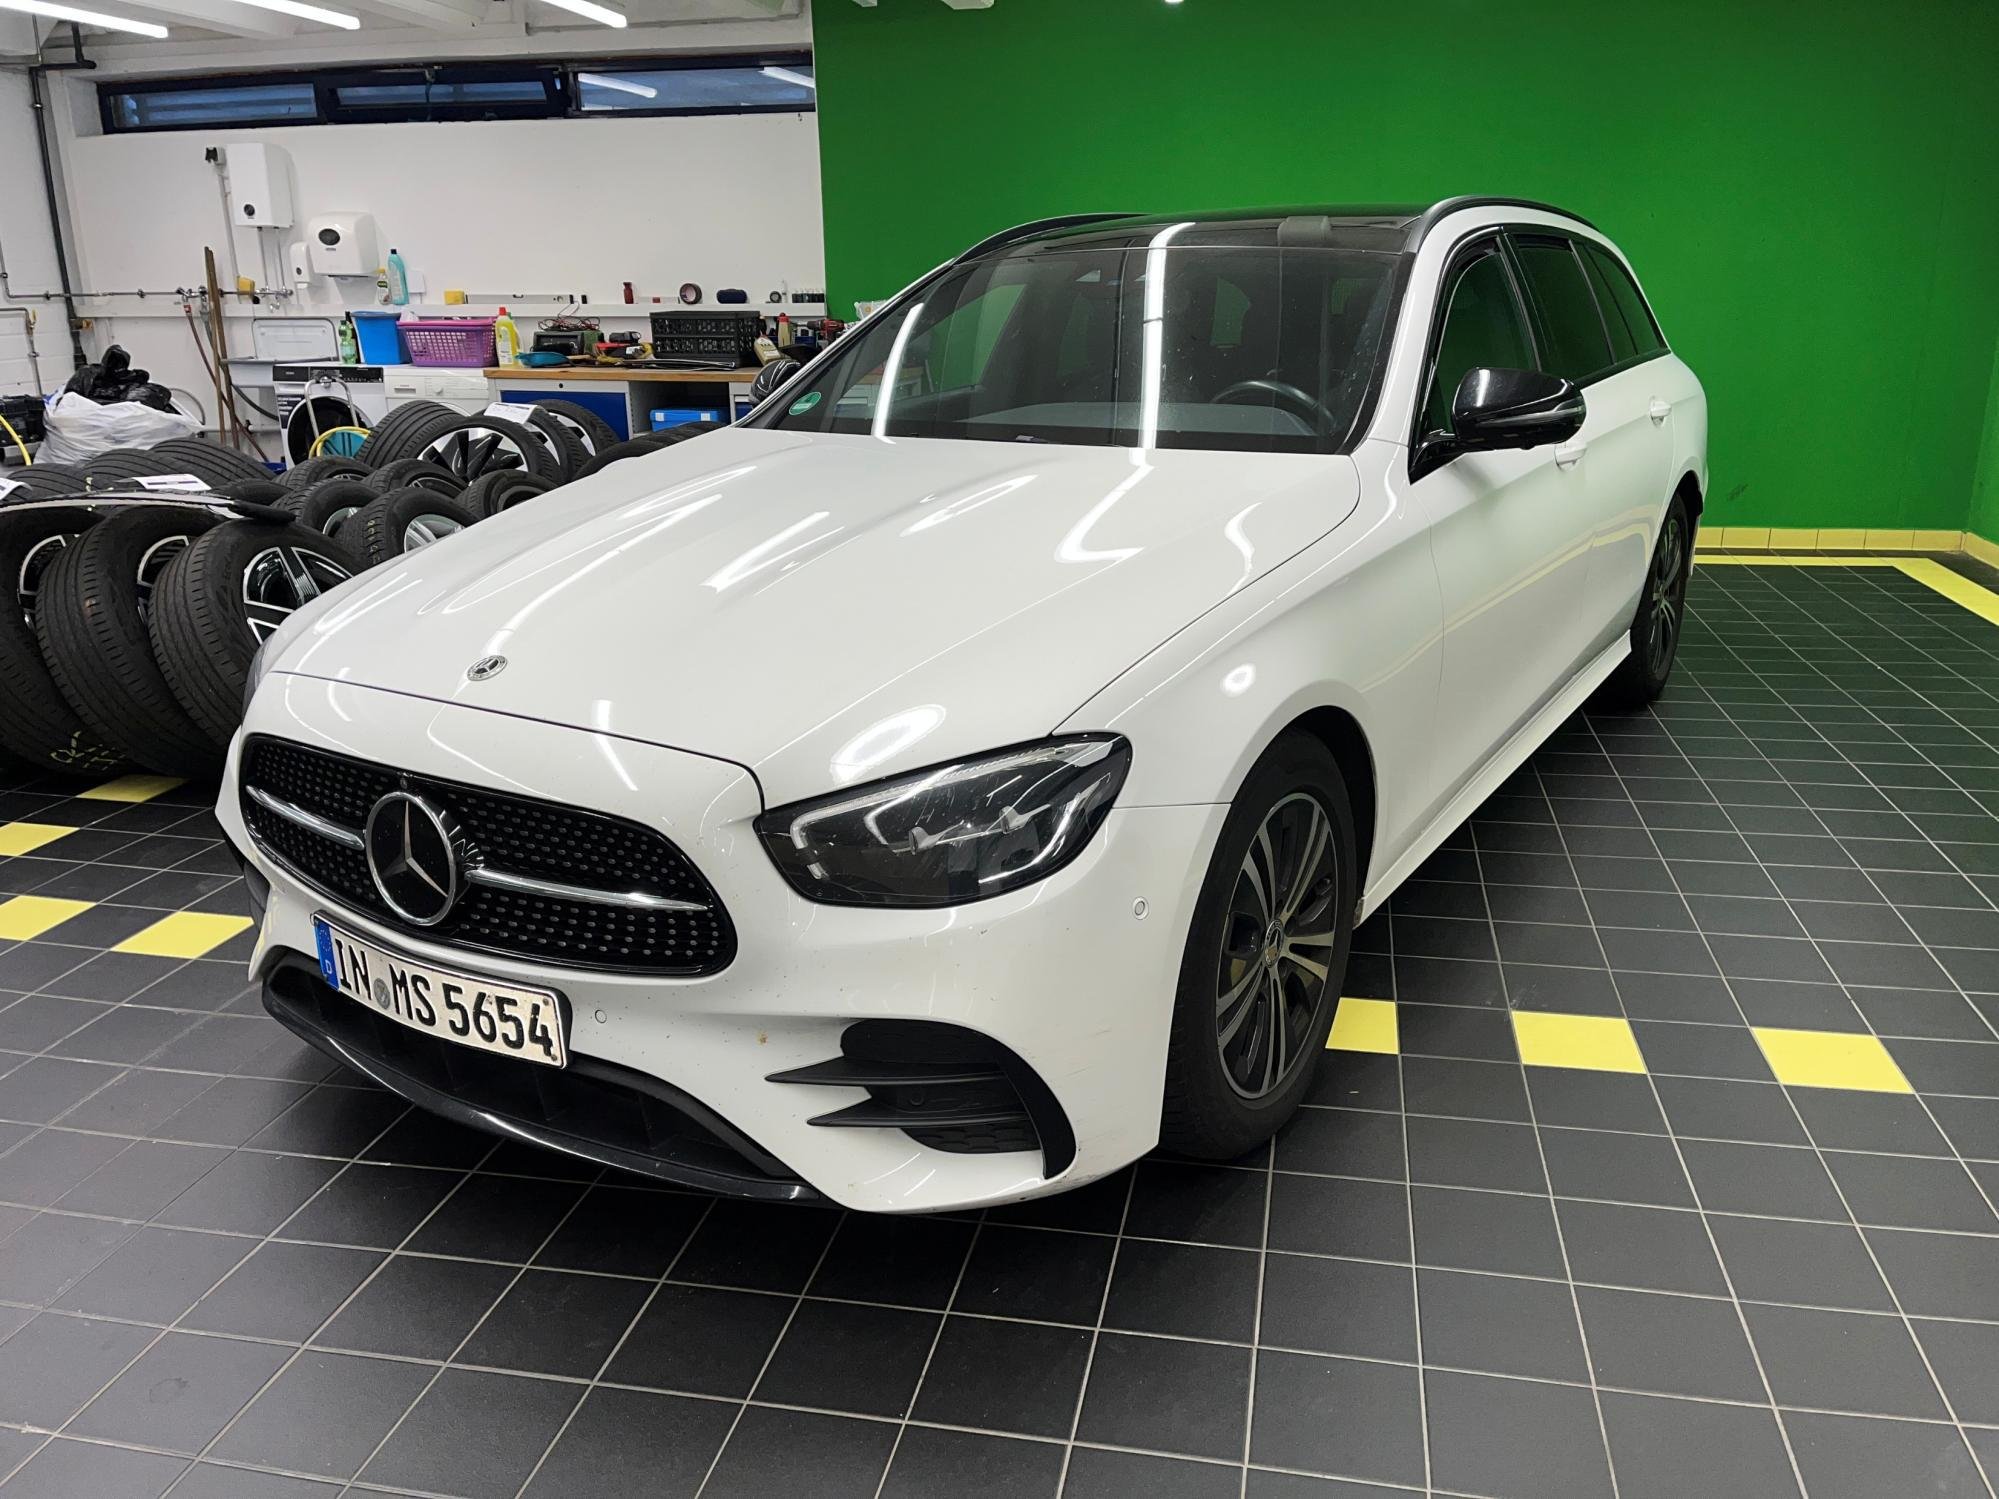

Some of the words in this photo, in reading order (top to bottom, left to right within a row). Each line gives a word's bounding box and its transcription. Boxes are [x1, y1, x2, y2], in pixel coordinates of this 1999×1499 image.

[325, 959, 333, 975] D
[334, 938, 372, 1001] IN
[388, 963, 437, 1027] MS
[442, 982, 554, 1058] 5654
